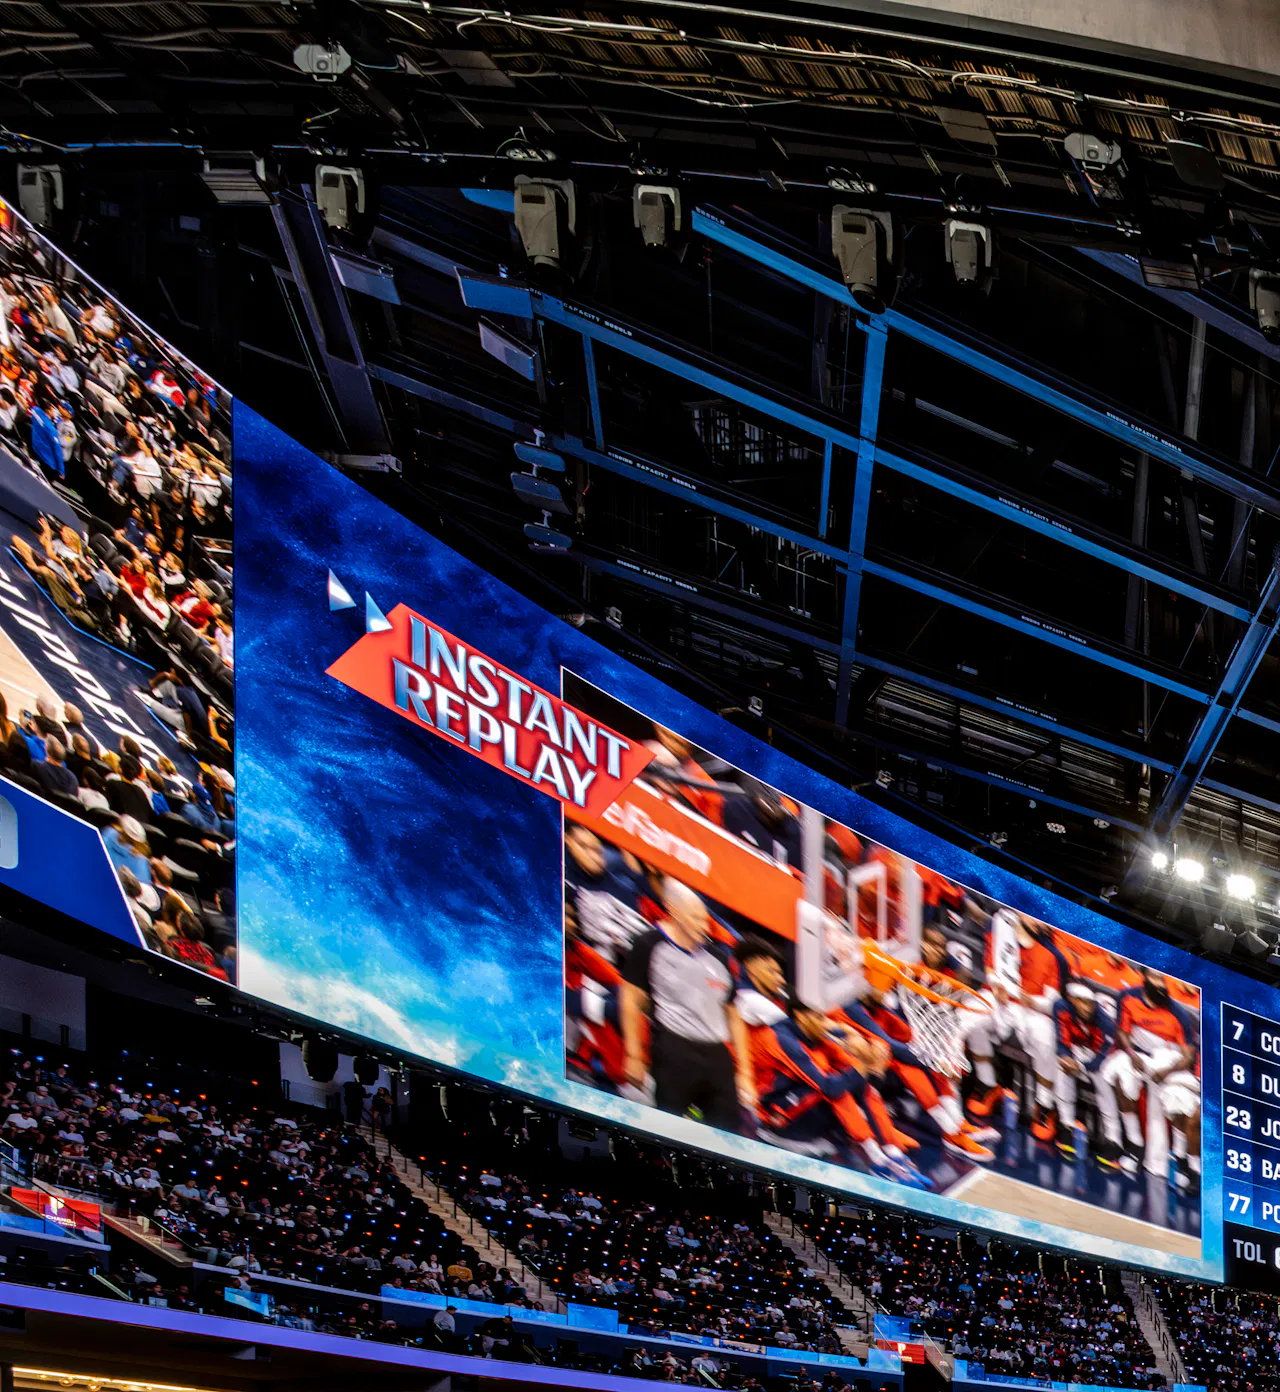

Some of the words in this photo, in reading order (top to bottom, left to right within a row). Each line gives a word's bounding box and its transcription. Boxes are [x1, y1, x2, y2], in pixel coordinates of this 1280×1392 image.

[409, 614, 629, 780] INSTANT
[392, 658, 597, 808] REPLAY
[1232, 1021, 1244, 1040] 7
[1232, 1064, 1245, 1084] 8
[1226, 1106, 1251, 1130] 23
[1227, 1150, 1251, 1172] 33
[1228, 1192, 1250, 1214] 77
[1232, 1239, 1266, 1264] TOL
